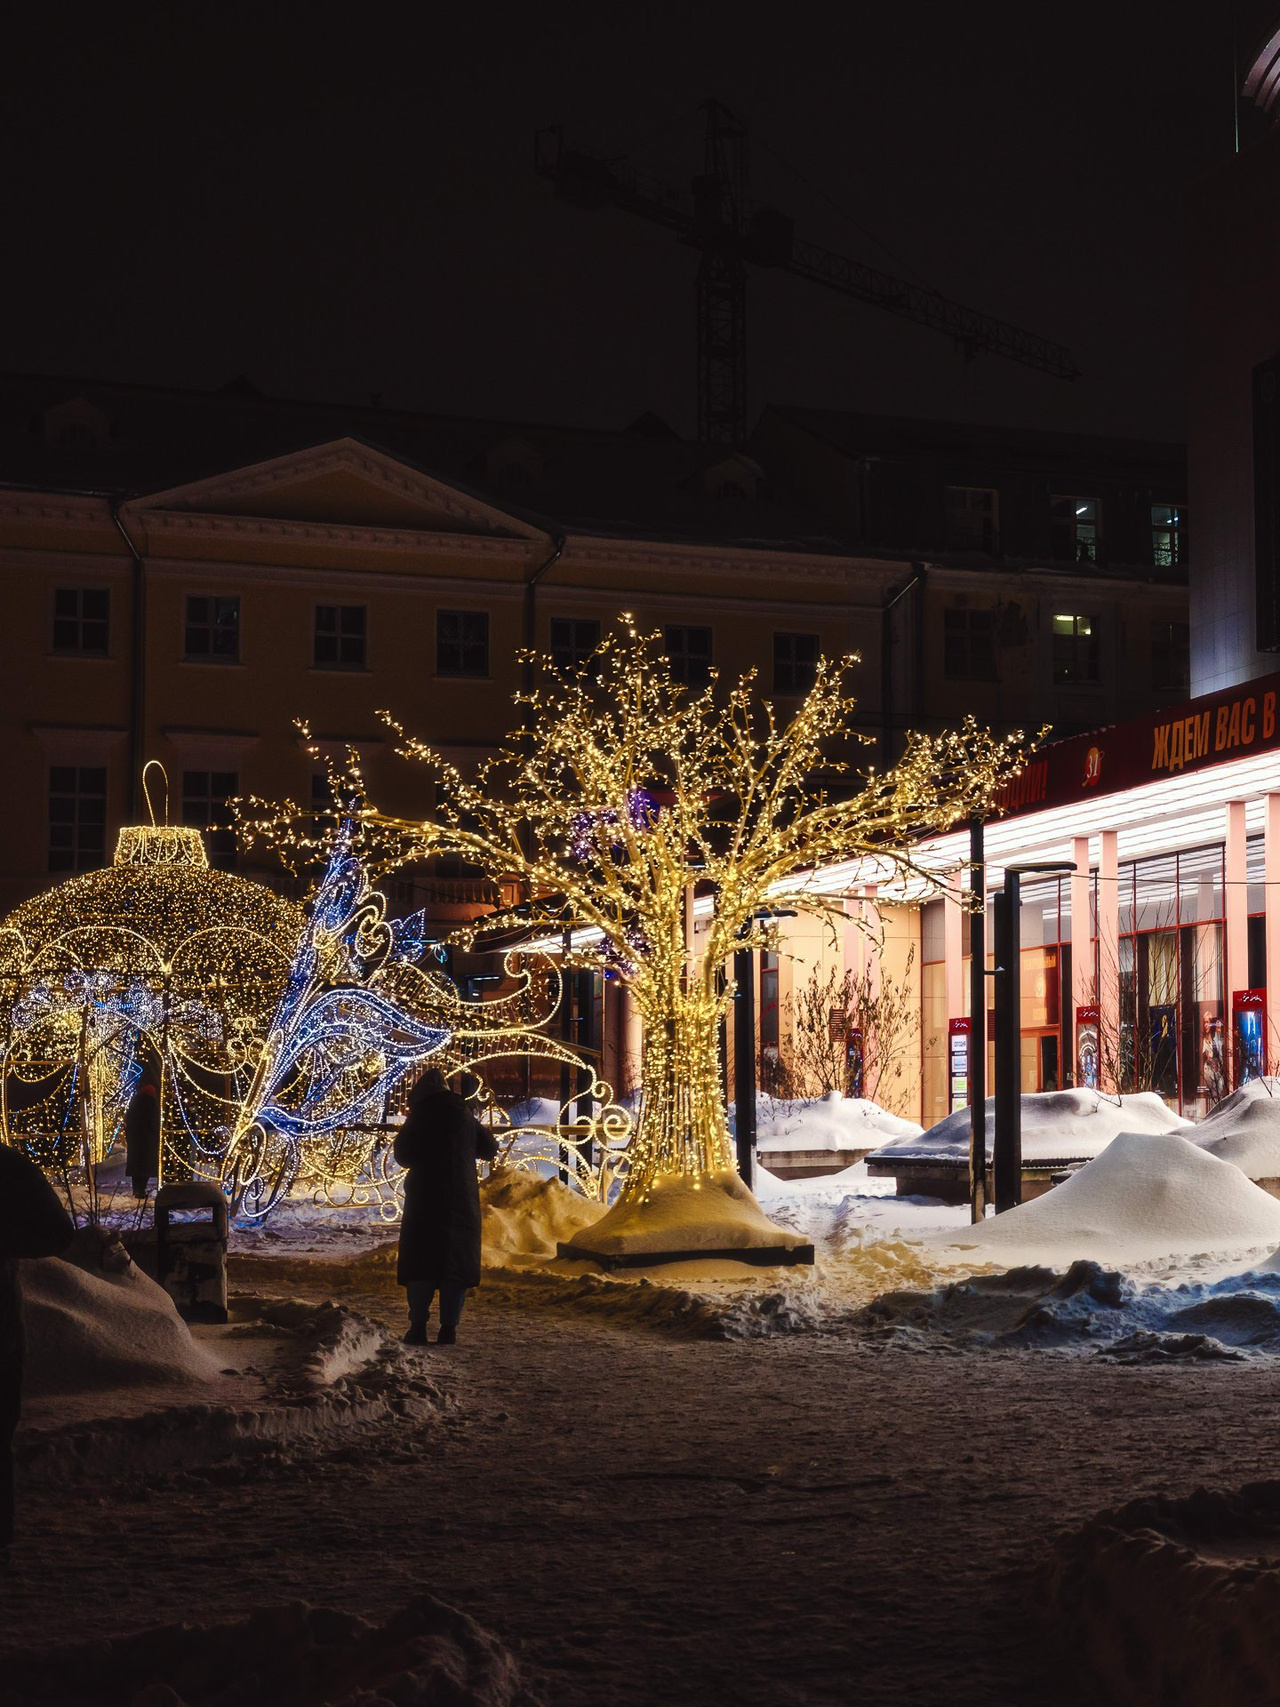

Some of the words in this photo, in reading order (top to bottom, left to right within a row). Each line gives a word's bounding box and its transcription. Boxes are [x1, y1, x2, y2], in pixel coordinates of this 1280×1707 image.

[1151, 710, 1210, 772] ЖДЕМ
[1214, 700, 1257, 751] ВАС
[1262, 691, 1276, 739] В
[1086, 754, 1099, 779] 31
